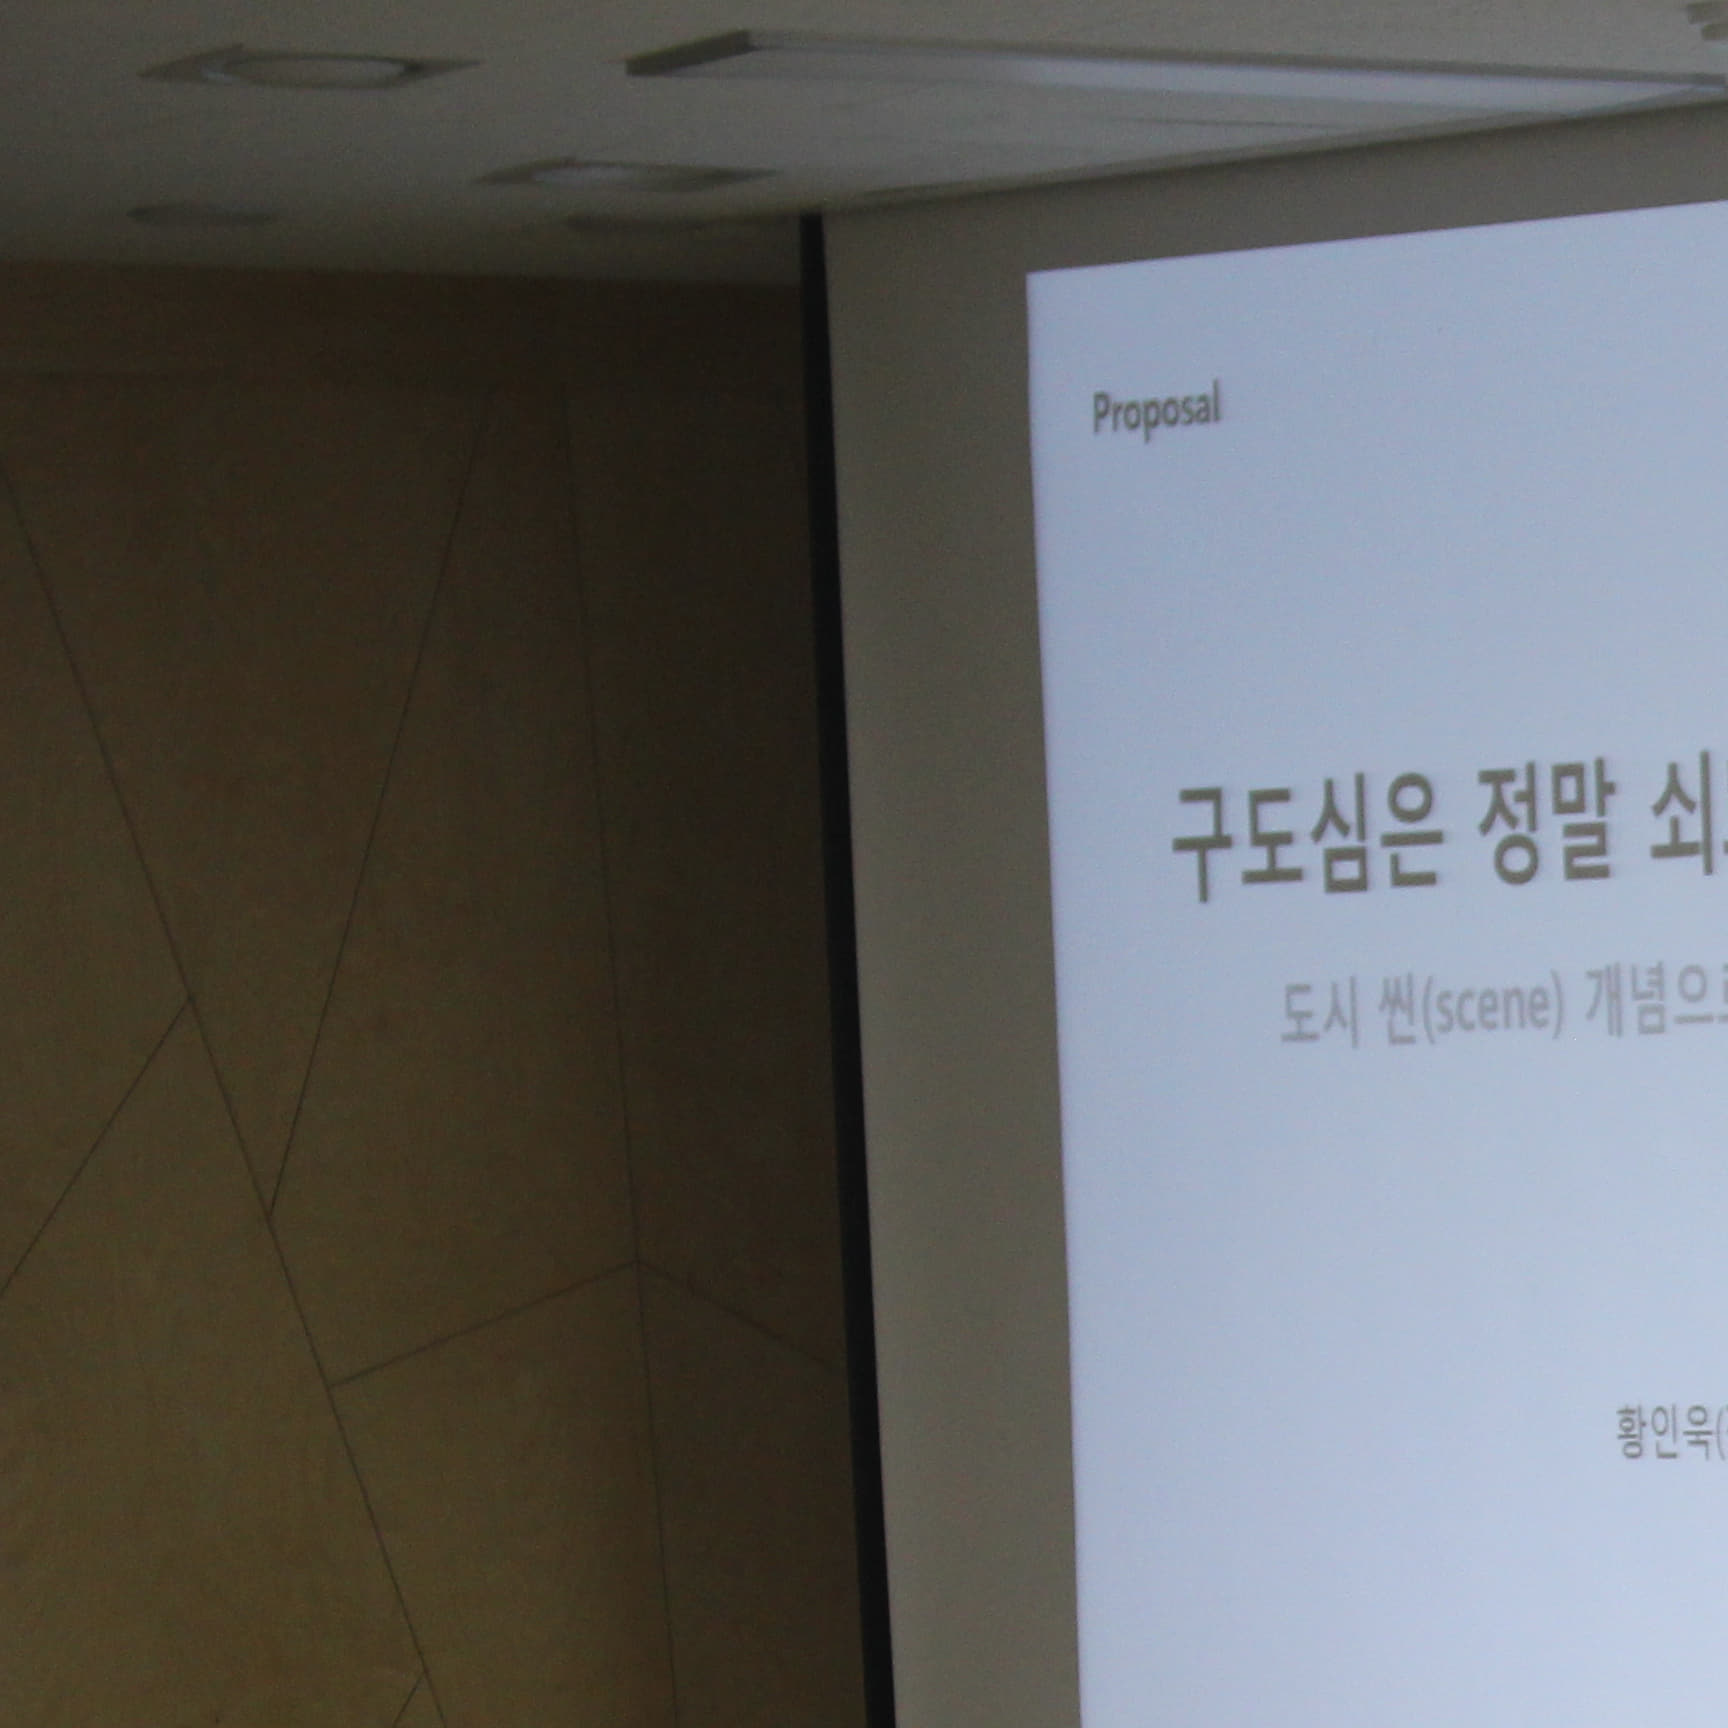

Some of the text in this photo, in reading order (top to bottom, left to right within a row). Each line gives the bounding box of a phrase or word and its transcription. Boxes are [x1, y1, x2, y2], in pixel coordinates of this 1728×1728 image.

[1093, 378, 1223, 444] Proposal
[1171, 771, 1446, 904] 구도심은
[1477, 756, 1618, 887] 정말
[1280, 975, 1360, 1050] 도시
[1377, 971, 1565, 1047] 씬(scene)
